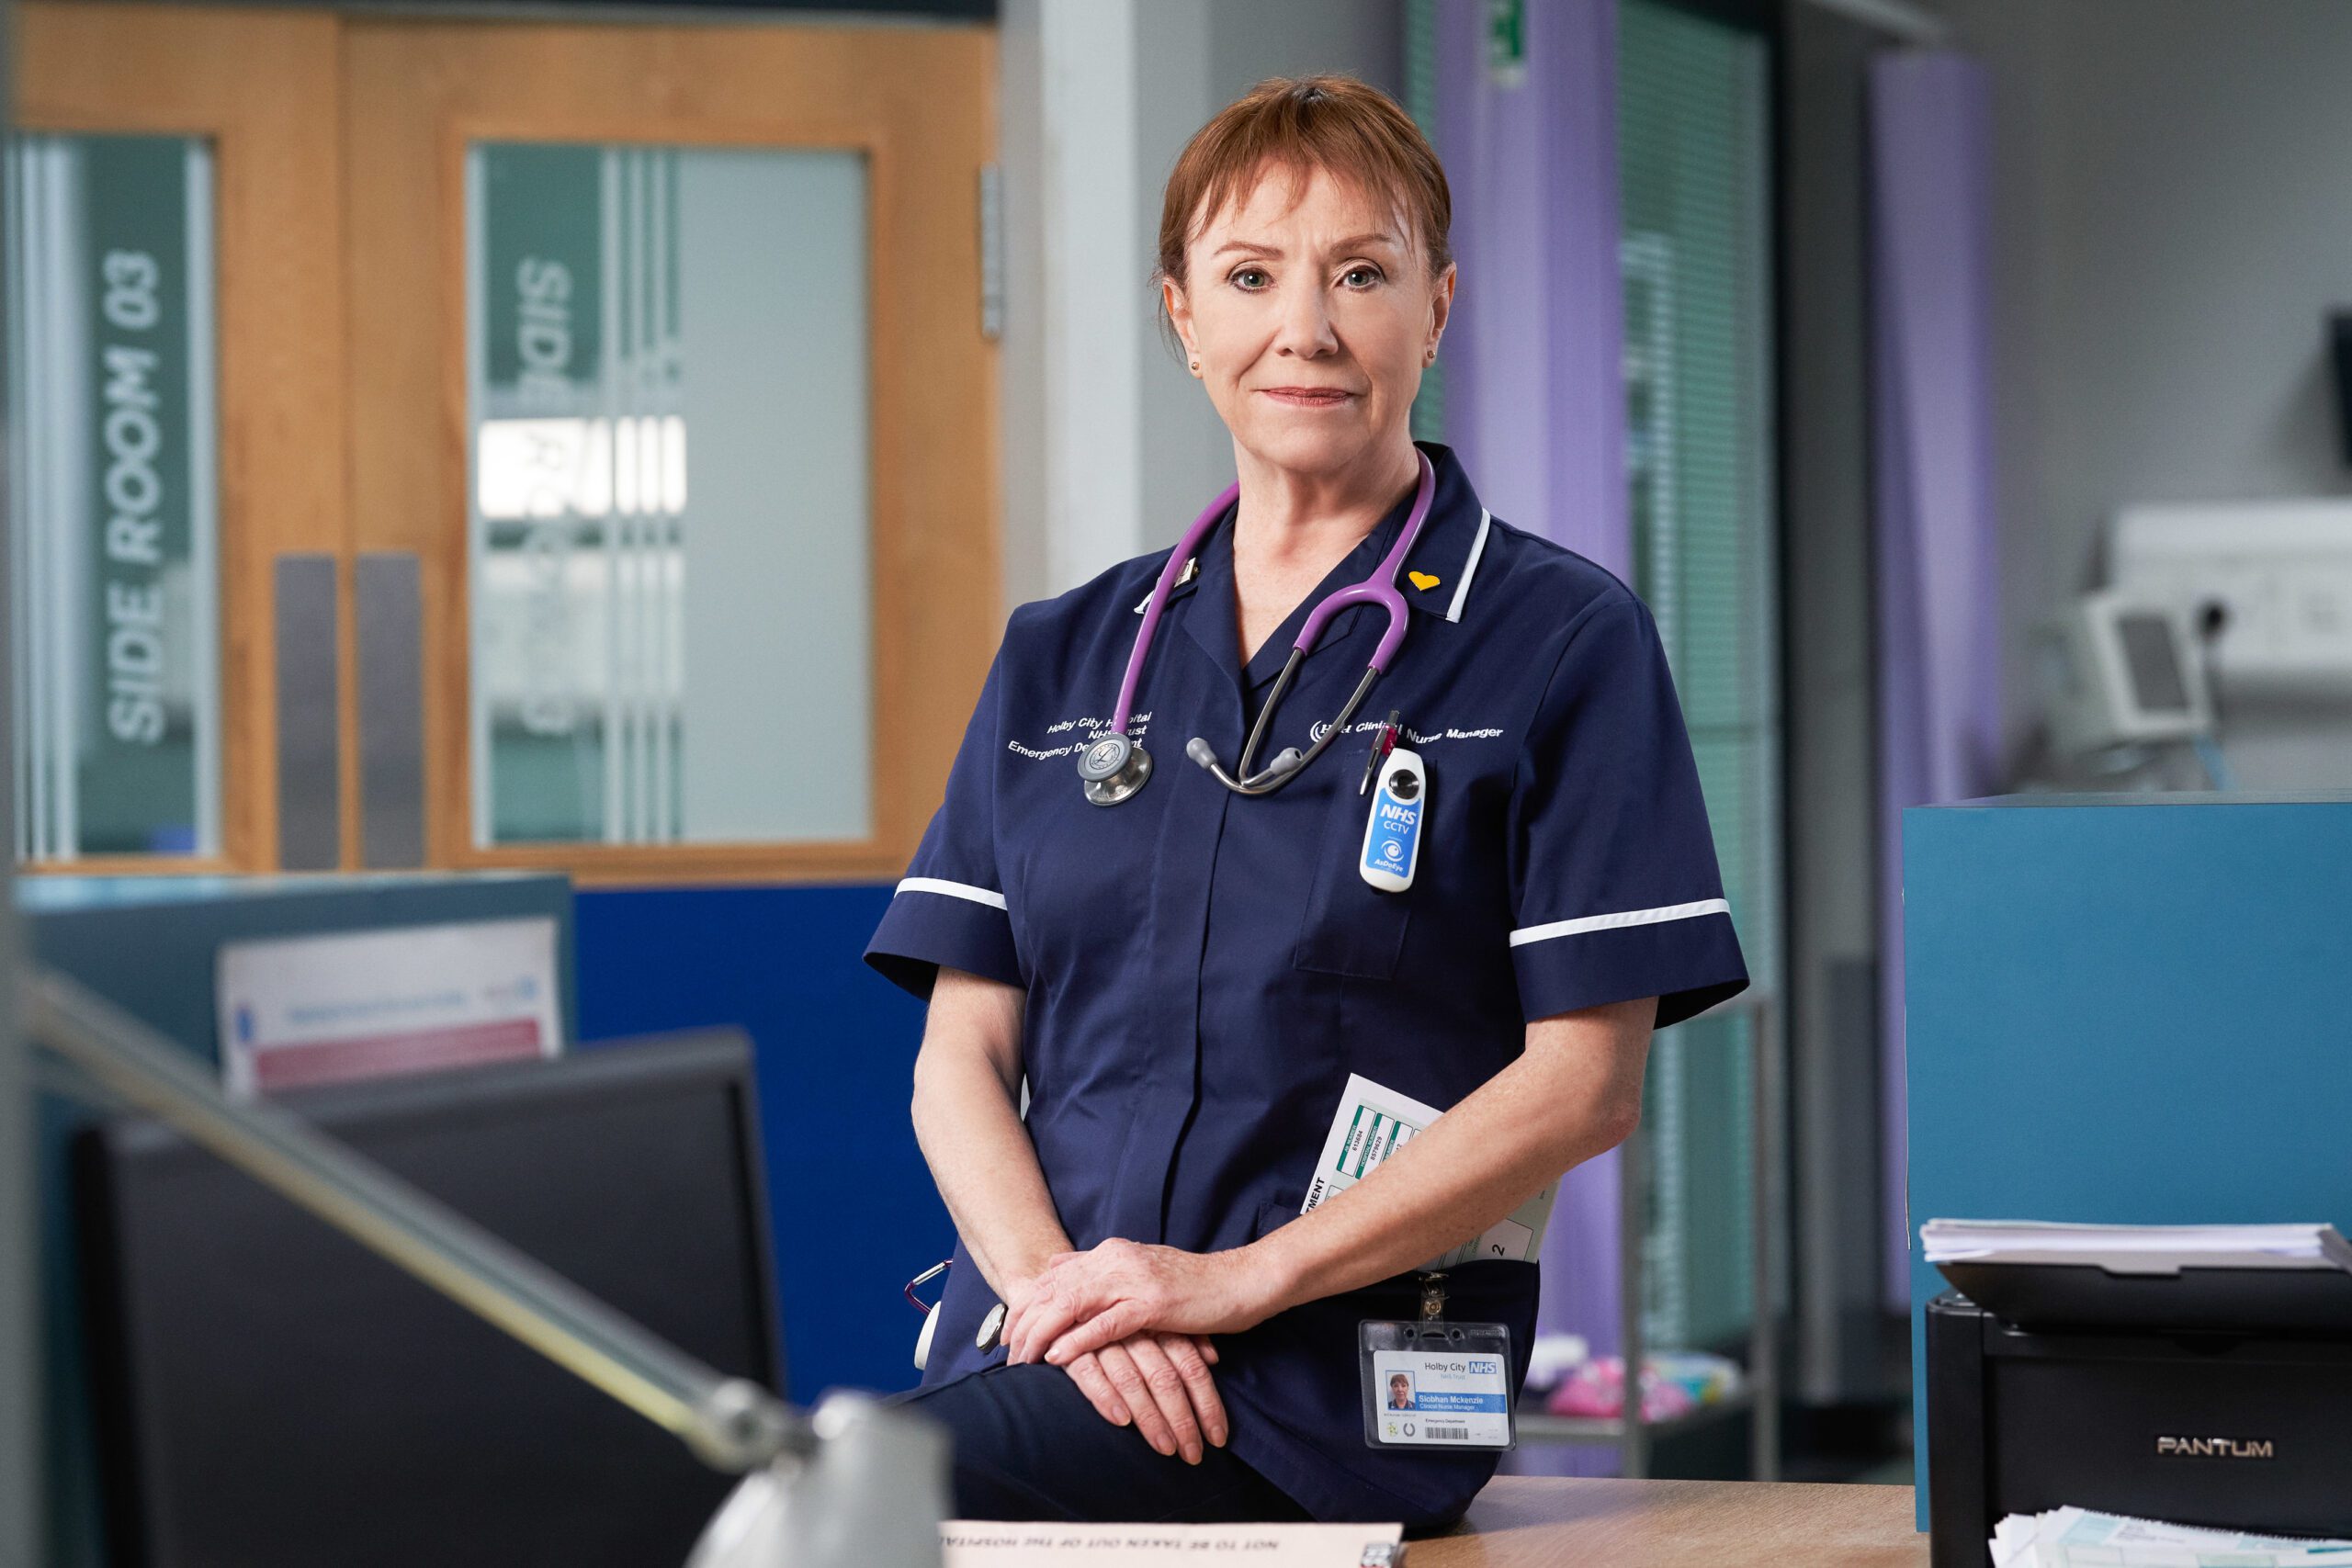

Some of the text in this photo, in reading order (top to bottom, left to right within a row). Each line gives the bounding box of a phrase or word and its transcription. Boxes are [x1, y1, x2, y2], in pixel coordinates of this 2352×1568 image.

[102, 248, 164, 746] SIDE ROOM 03
[1046, 711, 1152, 734] Holby City Hital
[1355, 720, 1403, 735] Clinil
[1407, 728, 1442, 744] Nurse
[1446, 728, 1504, 739] Manager
[1008, 740, 1072, 761] Emergency
[1380, 804, 1417, 825] NHS
[1384, 820, 1409, 834] CCTV
[1374, 859, 1404, 873] AsDoEye
[1351, 1130, 1363, 1152] 613684
[1491, 1244, 1505, 1257] 2
[1425, 1362, 1496, 1373] Holby City NHS
[1419, 1395, 1484, 1404] Siobhan Mckenzie
[2157, 1436, 2274, 1459] PANTUM
[1024, 1537, 1053, 1548] THE
[1060, 1538, 1081, 1549] OF
[1088, 1538, 1121, 1549] OUT
[1126, 1539, 1182, 1550] TAKEN
[1190, 1540, 1210, 1550] BE
[1216, 1540, 1236, 1551] TO
[1244, 1539, 1279, 1550] NOT
